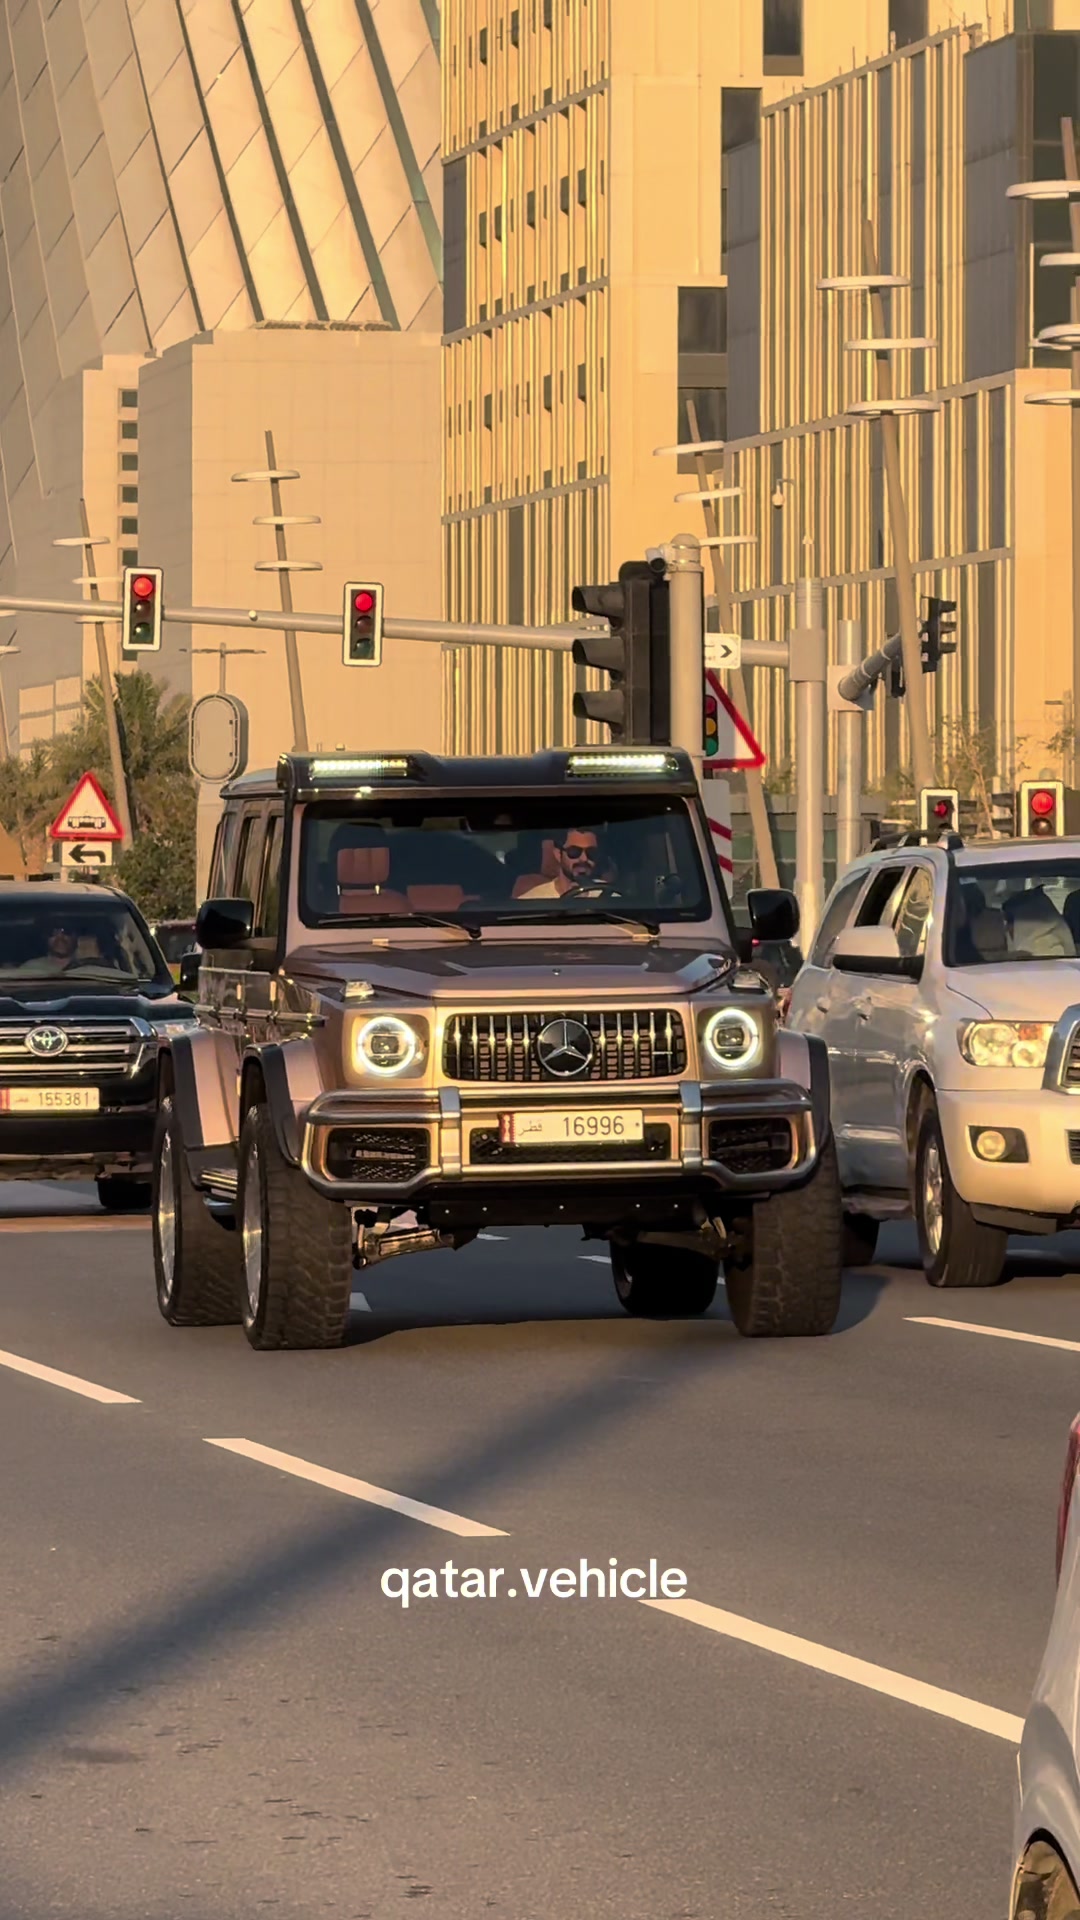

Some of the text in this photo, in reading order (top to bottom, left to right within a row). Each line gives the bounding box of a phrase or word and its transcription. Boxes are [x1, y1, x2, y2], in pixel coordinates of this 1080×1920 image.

[38, 1091, 89, 1107] 155381
[518, 1115, 625, 1137] قطر 16996
